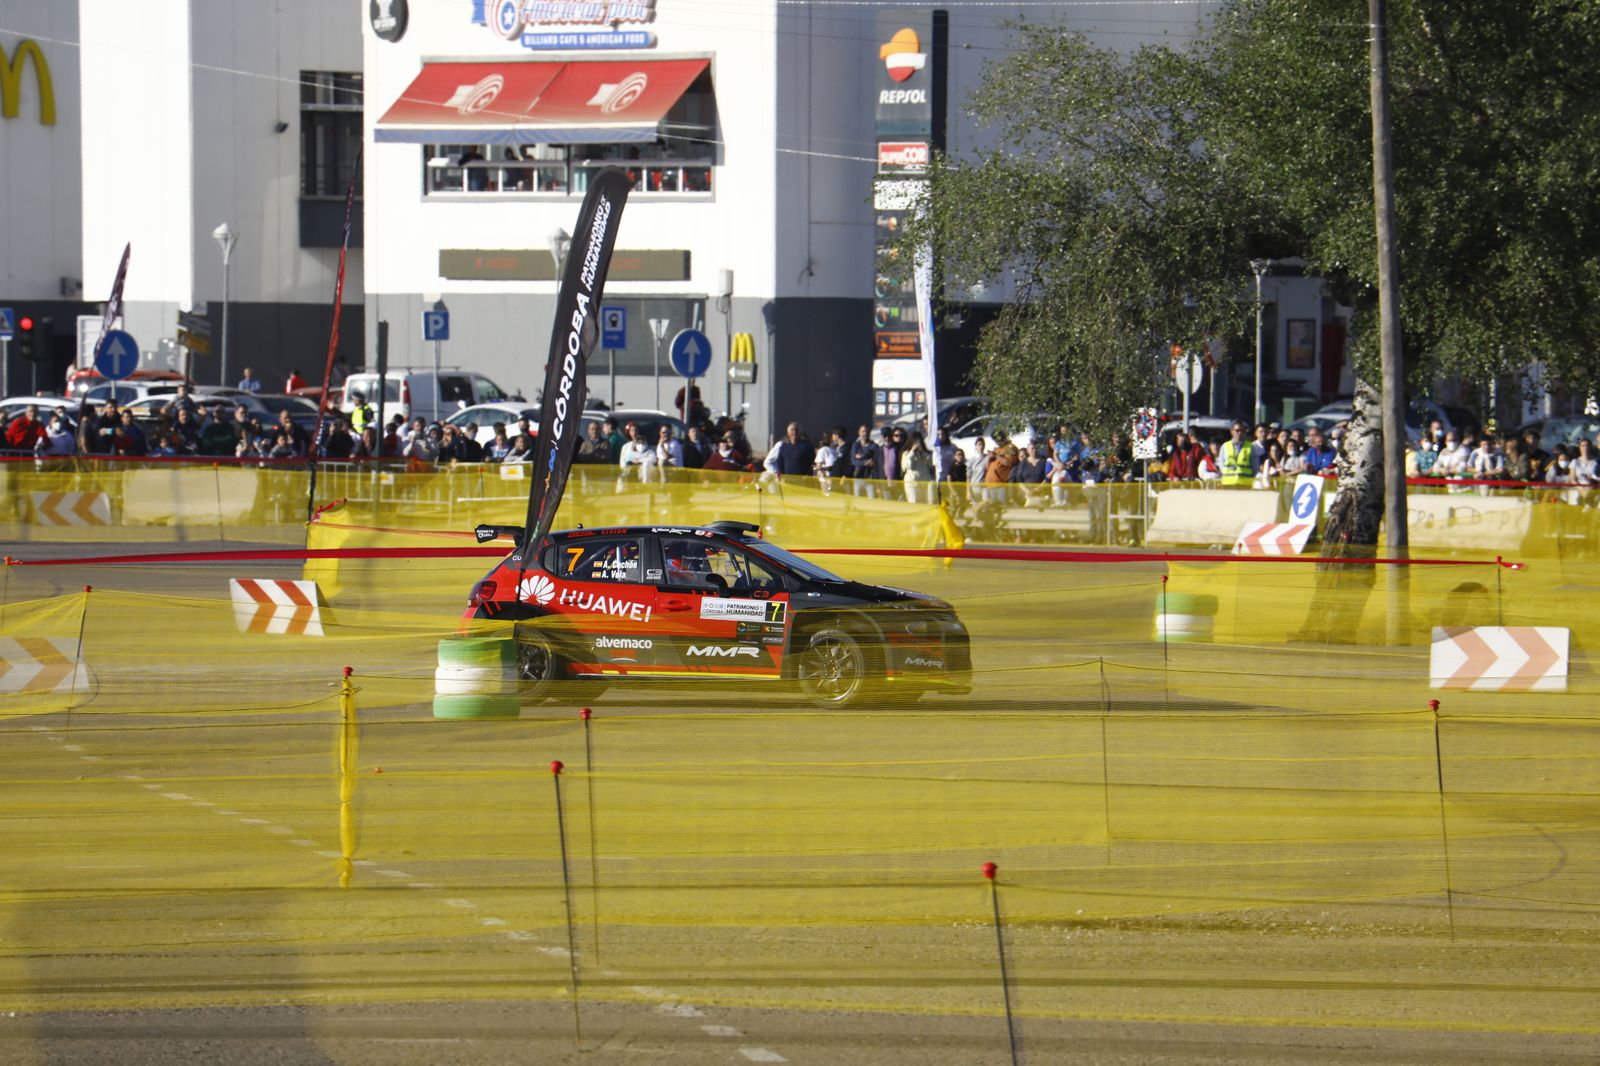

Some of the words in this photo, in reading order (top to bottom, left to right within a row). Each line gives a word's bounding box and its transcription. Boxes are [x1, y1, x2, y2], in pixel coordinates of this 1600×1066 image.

[879, 89, 927, 104] REPSOL
[581, 204, 604, 284] PATRIMONIO
[585, 201, 611, 292] HUMANIDAD
[429, 314, 445, 338] P
[553, 292, 590, 441] CÓRDOBA
[567, 548, 585, 573] 7
[559, 588, 652, 623] HUAWEI
[771, 602, 780, 623] 7
[595, 636, 652, 649] alvemaco
[686, 645, 760, 658] MMR
[904, 656, 944, 669] MMR
